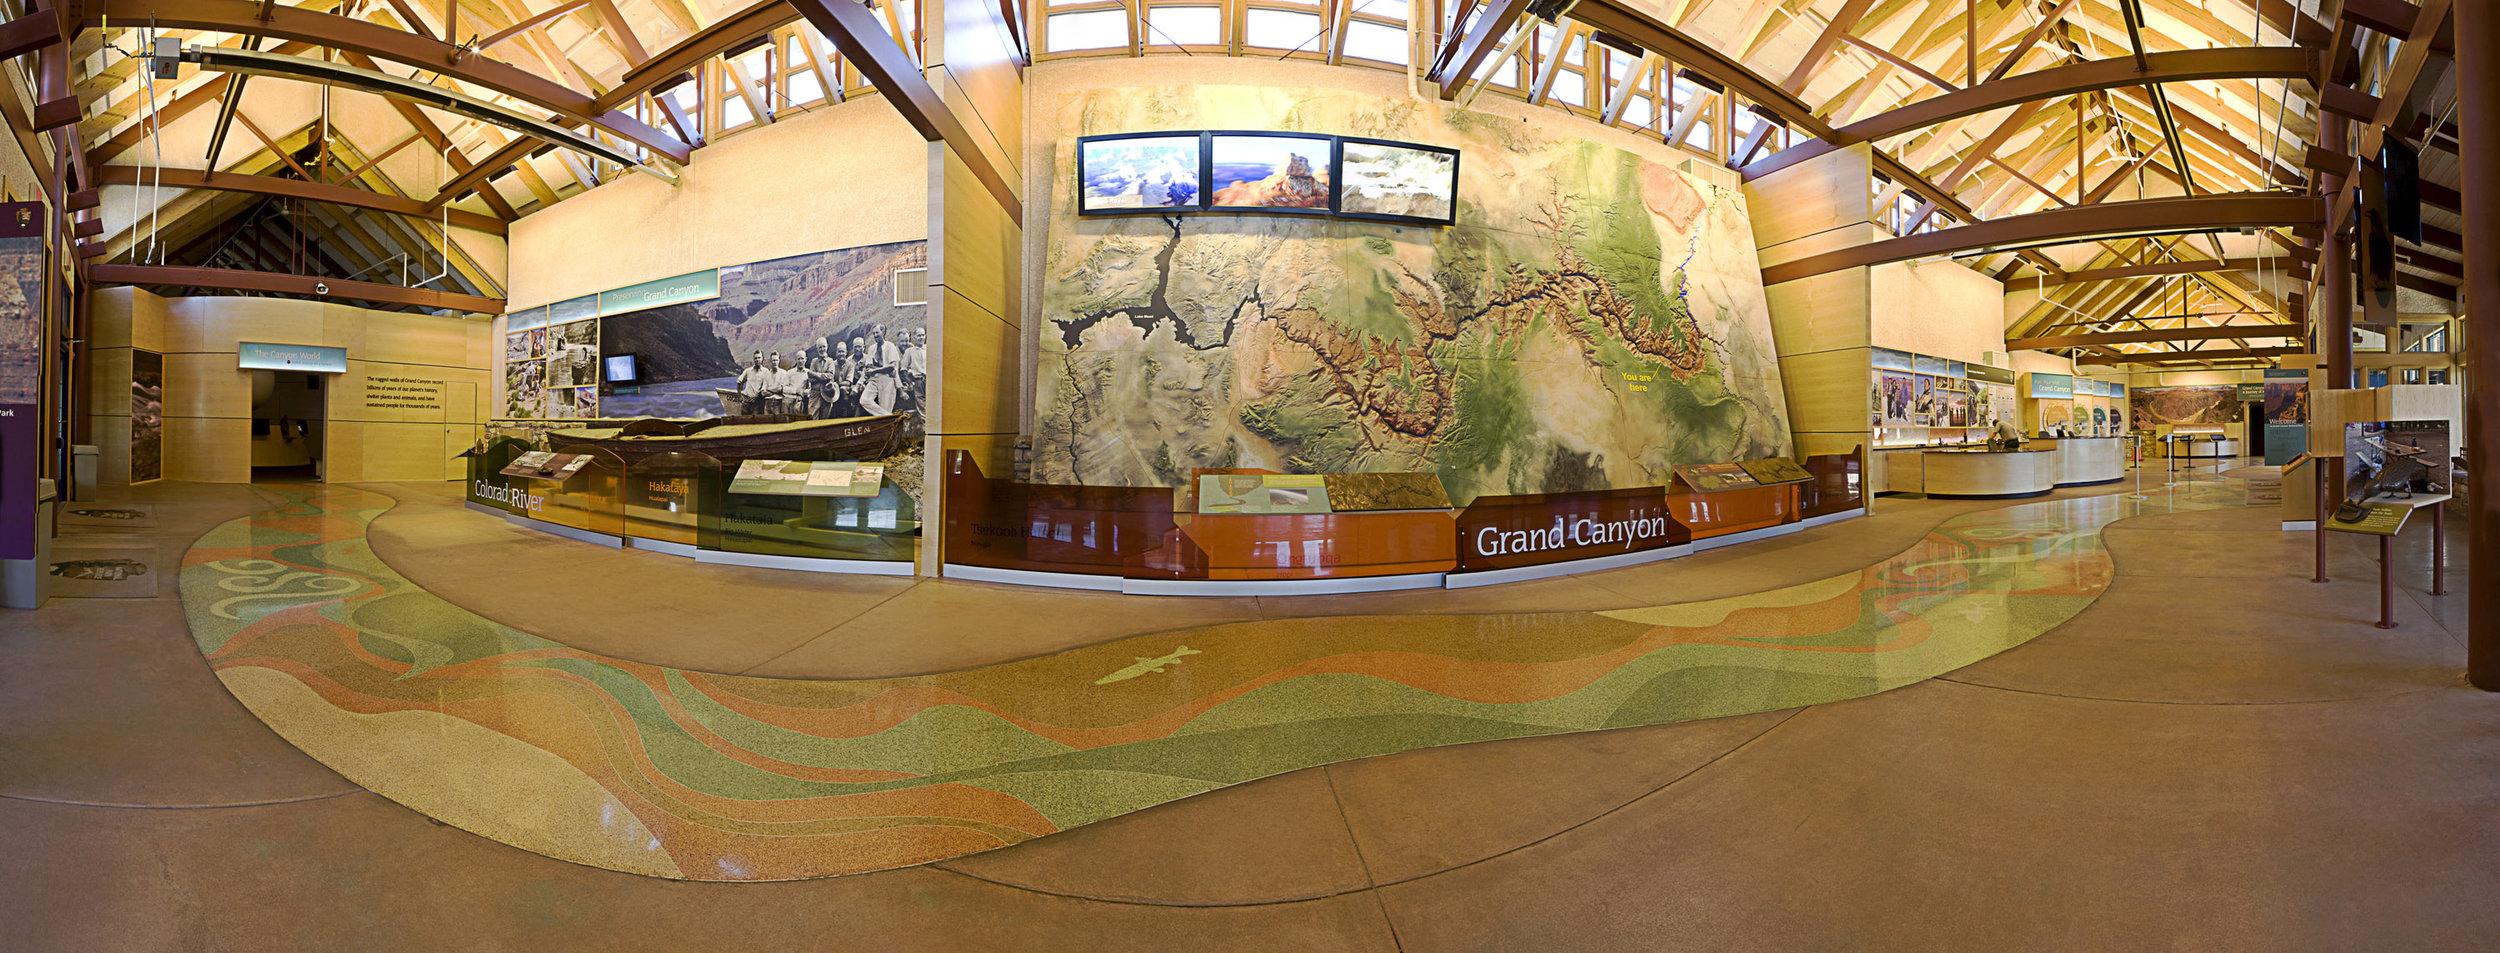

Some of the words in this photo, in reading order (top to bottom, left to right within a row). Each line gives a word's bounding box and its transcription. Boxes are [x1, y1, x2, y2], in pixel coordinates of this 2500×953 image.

[643, 287, 667, 302] Grand
[668, 284, 700, 297] Canyon
[255, 349, 268, 358] The
[270, 350, 298, 360] Canyon
[299, 351, 321, 360] World
[1621, 371, 1638, 381] You
[1629, 383, 1648, 392] here
[2053, 385, 2071, 393] Canyon
[0, 408, 14, 417] ark
[2269, 417, 2297, 425] Welcome
[844, 425, 871, 438] GLEN
[649, 480, 689, 497] Hakataya
[474, 478, 513, 504] Colorado
[511, 487, 545, 512] River
[1476, 516, 1566, 557] Grand
[1574, 515, 1666, 550] Canyon
